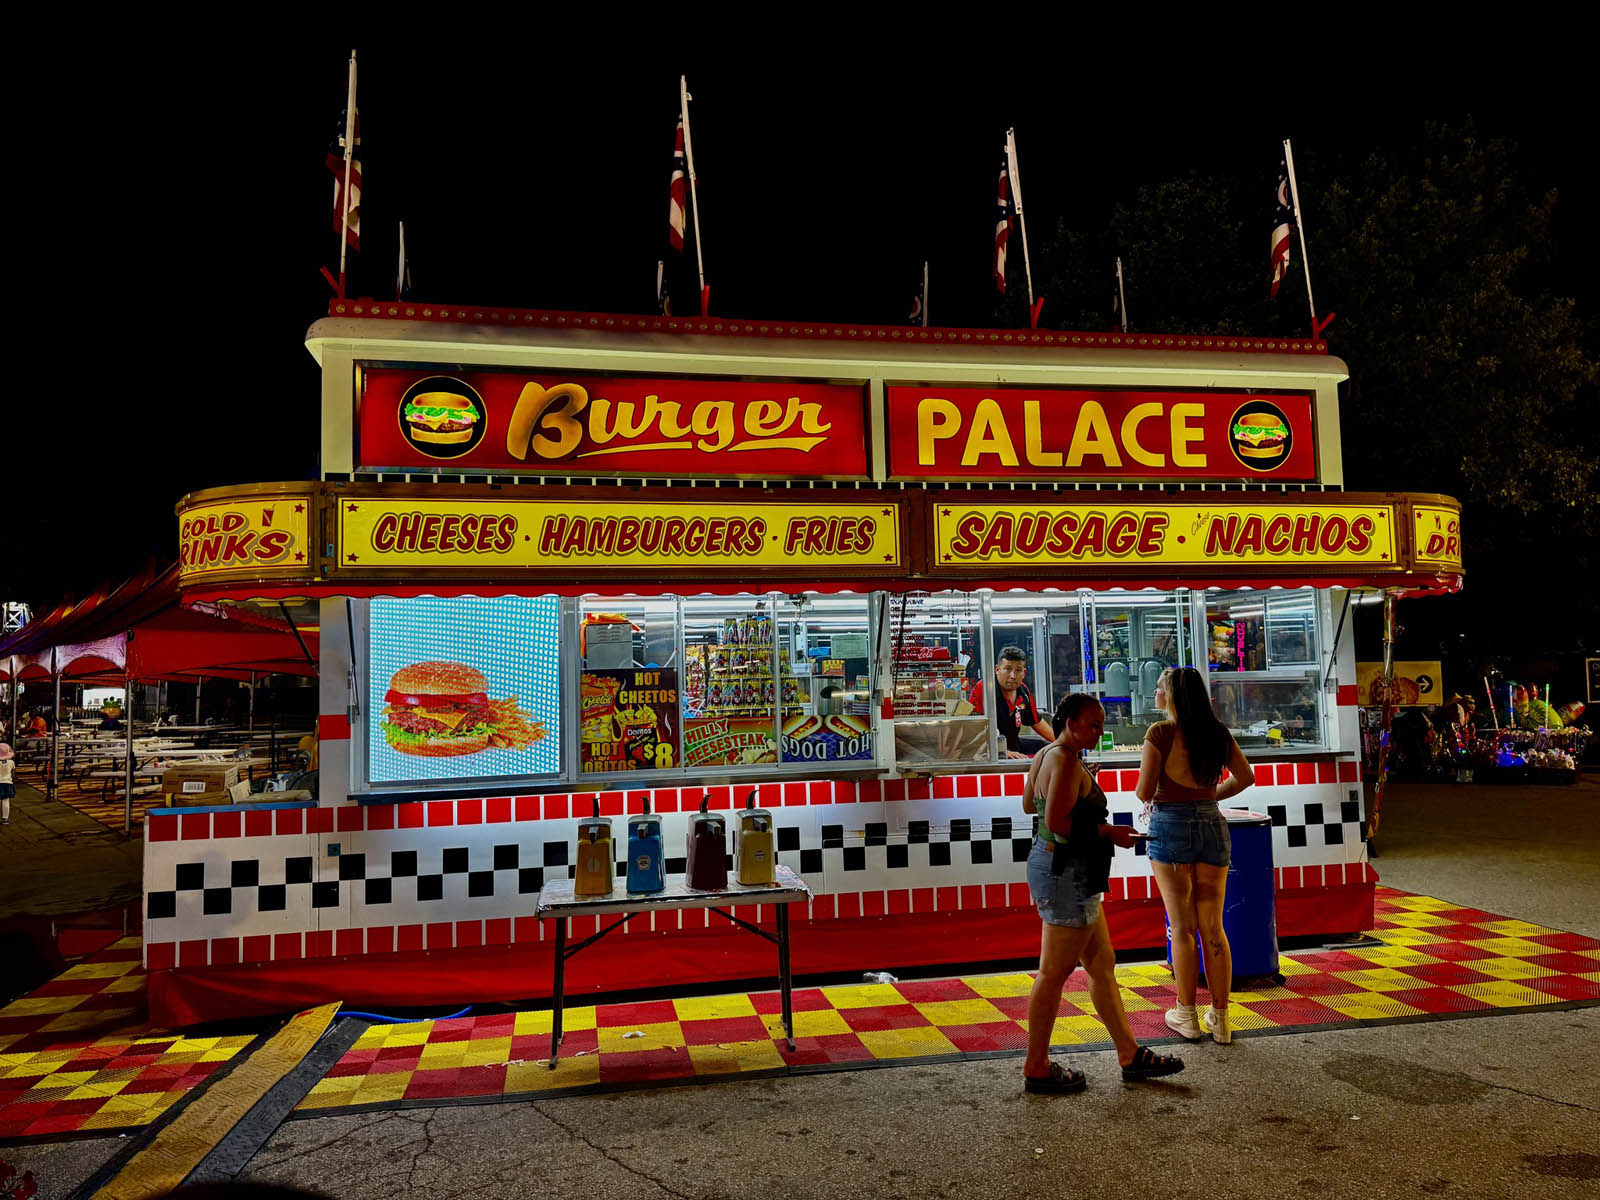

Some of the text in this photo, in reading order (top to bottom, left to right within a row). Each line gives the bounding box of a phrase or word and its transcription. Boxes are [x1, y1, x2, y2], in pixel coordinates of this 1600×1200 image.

[506, 381, 832, 460] Burger
[917, 398, 1207, 468] PALACE
[182, 513, 248, 541] COLD
[373, 512, 877, 557] CHEESES HAMBURGERS FRIES
[951, 511, 1376, 557] SAUSAGE NACHOS
[180, 531, 294, 568] RINKS
[634, 672, 661, 686] HOT
[619, 689, 677, 705] CHEETOS
[627, 728, 652, 736] Doritos
[685, 718, 728, 745] HILLY
[781, 731, 871, 760] HOT DOGS
[591, 742, 620, 756] HOT
[686, 733, 766, 767] HEESESTEAK
[583, 759, 637, 773] ORITOS
